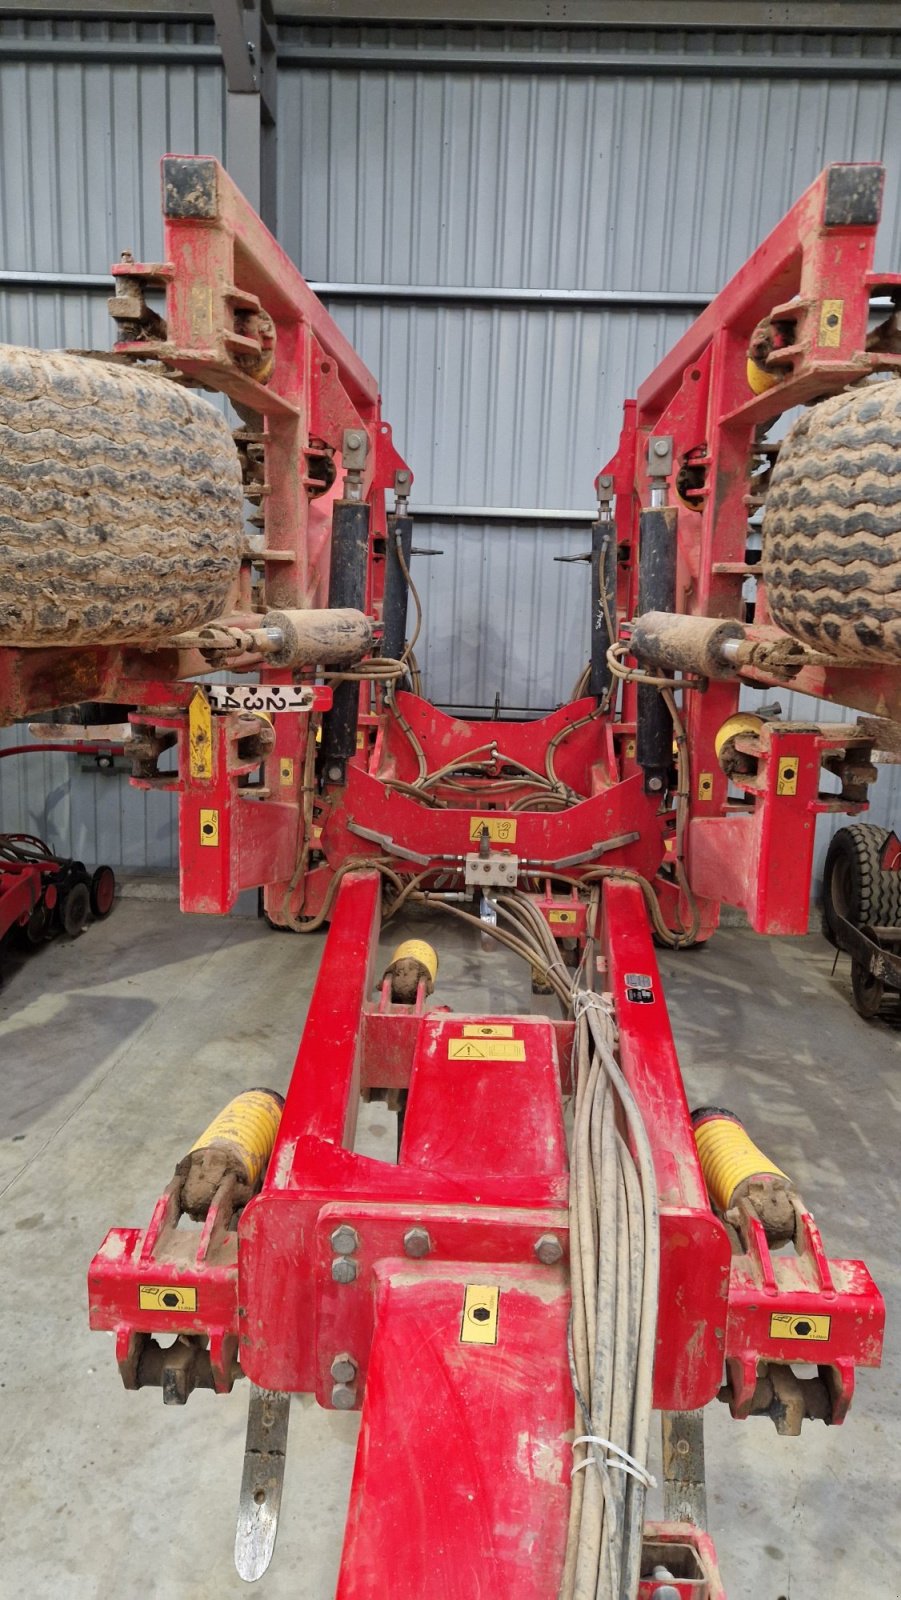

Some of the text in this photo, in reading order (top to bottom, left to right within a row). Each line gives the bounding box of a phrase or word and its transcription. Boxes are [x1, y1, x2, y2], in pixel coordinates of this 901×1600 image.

[221, 696, 240, 709] 4
[243, 697, 264, 710] 3
[266, 697, 286, 710] 2
